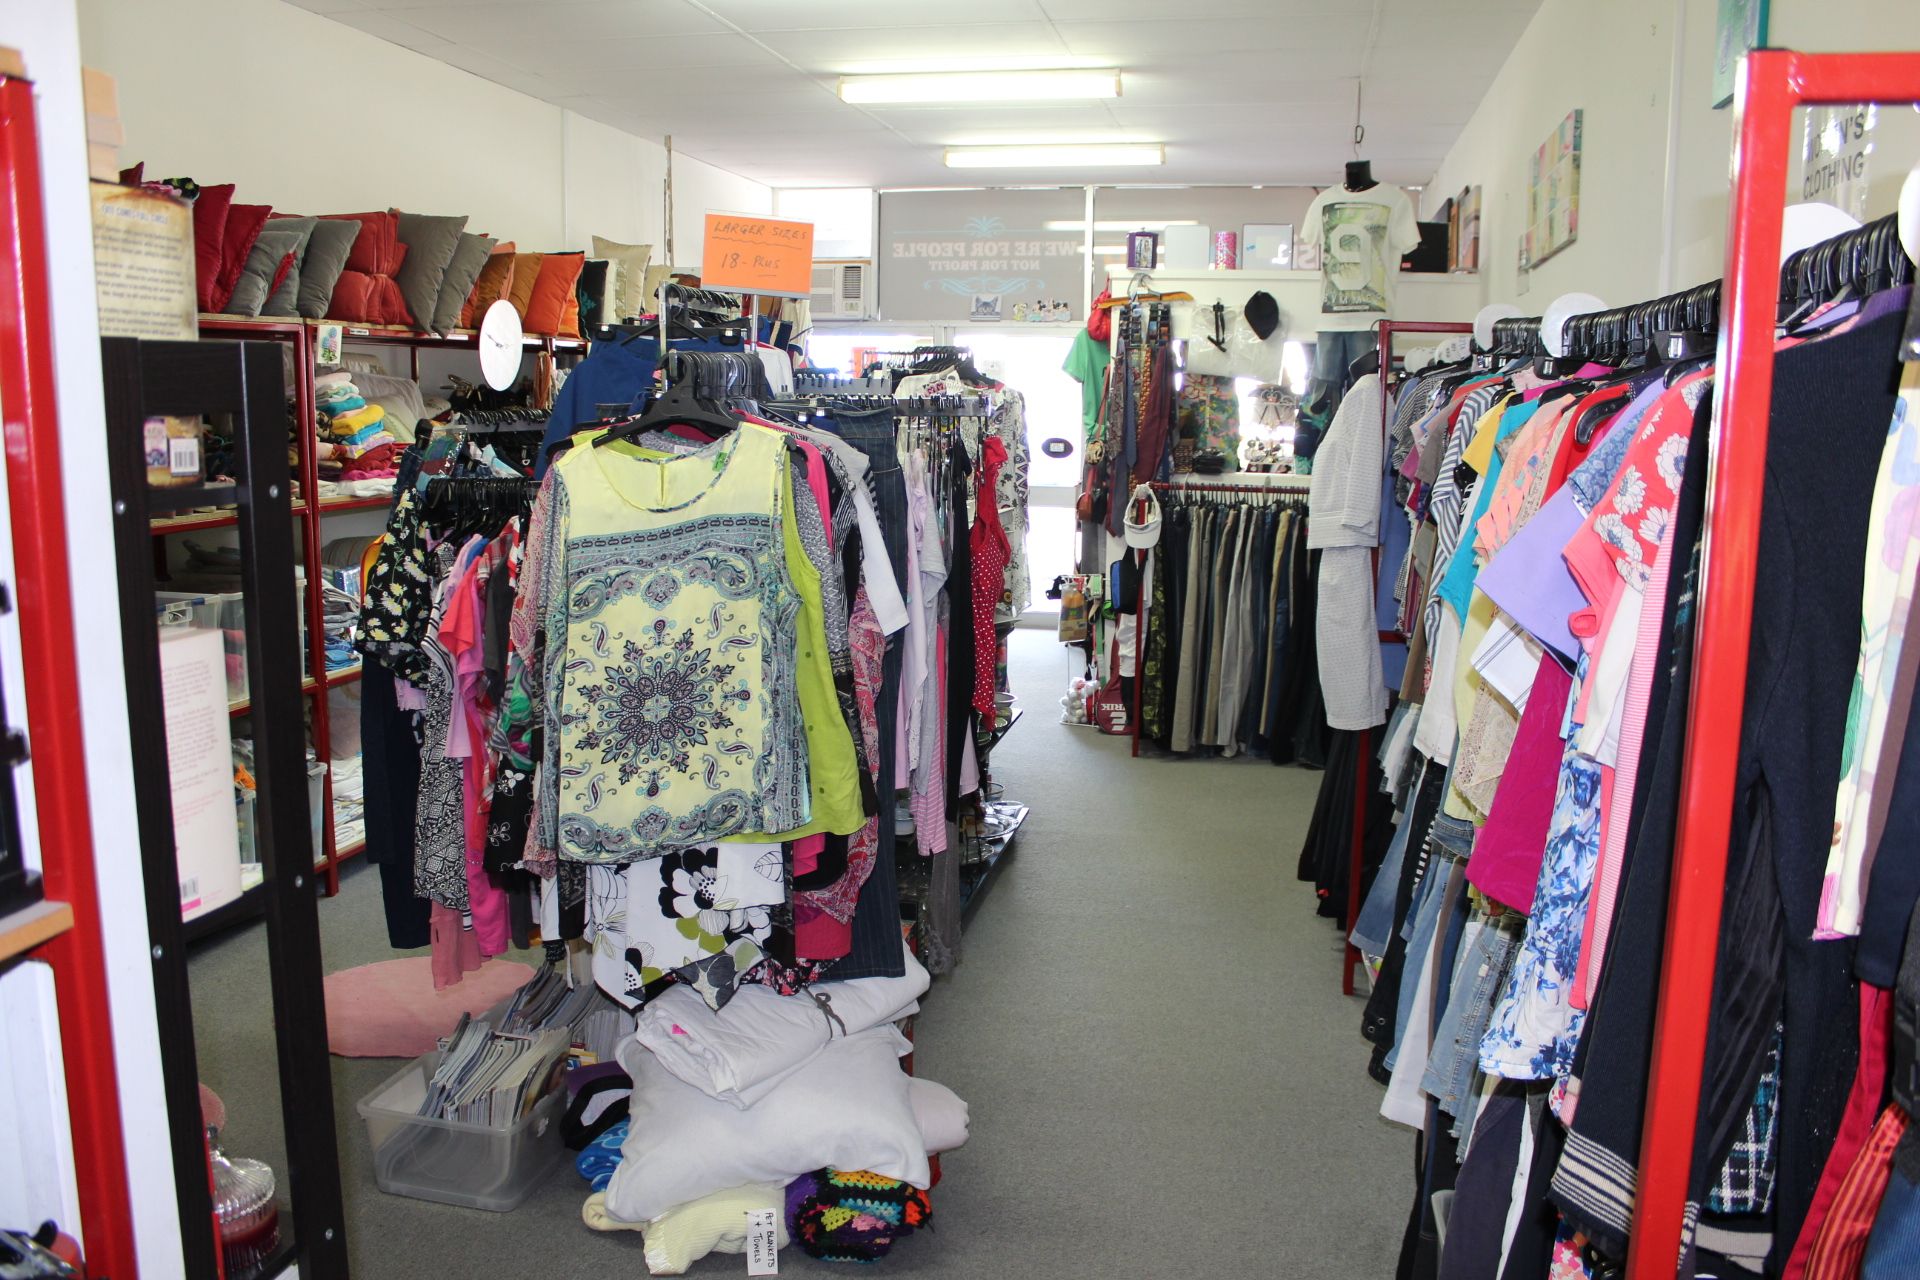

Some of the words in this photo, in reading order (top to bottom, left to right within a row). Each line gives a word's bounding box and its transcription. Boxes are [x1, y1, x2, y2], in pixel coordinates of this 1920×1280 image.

[713, 222, 766, 236] LARGER
[771, 227, 808, 240] SIZES
[1329, 223, 1371, 291] 9
[765, 1212, 774, 1226] PET
